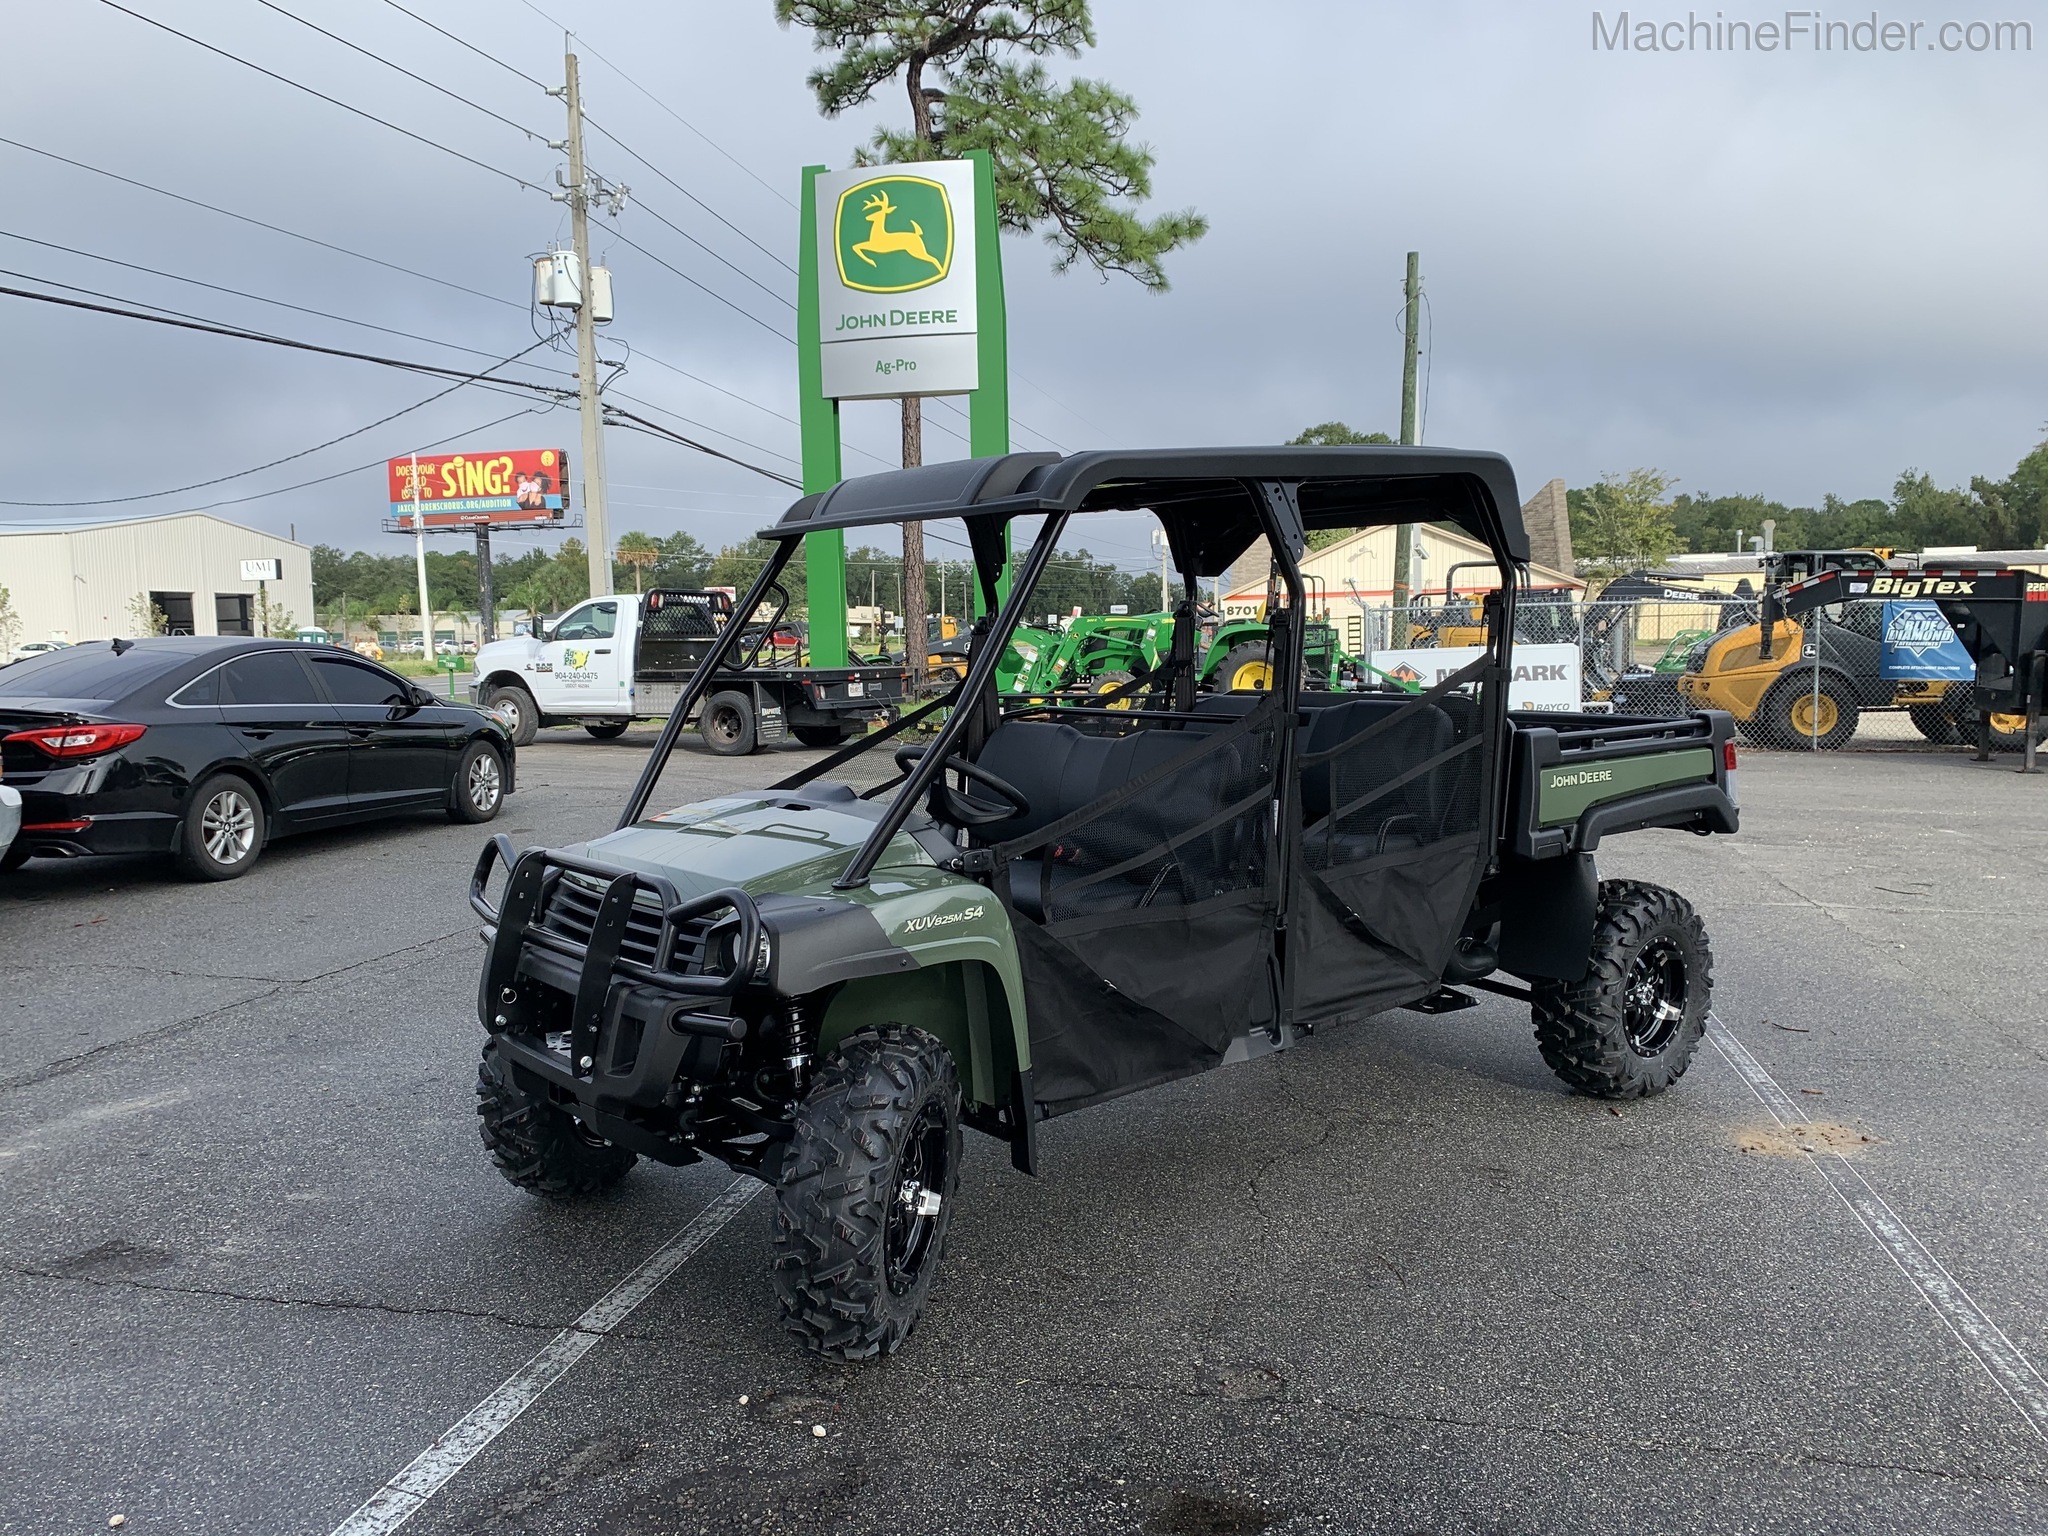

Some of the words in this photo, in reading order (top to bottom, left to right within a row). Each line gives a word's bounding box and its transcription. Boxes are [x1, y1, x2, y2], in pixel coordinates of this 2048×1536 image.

[835, 312, 886, 331] JOHN
[889, 309, 958, 326] DEERE
[875, 358, 917, 375] Ag-Pro
[422, 487, 432, 499] TO
[245, 560, 271, 572] UMI
[1663, 588, 1700, 600] DEERE
[1226, 605, 1258, 616] 8701
[1903, 620, 1939, 631] BLUE
[1888, 629, 1953, 641] DIAMOND
[554, 672, 599, 680] 904-240-0475
[1436, 664, 1568, 685] MARK
[1536, 703, 1570, 711] RAYCO
[1550, 774, 1578, 788] JOHN
[1579, 770, 1612, 784] DEERE
[903, 912, 963, 933] XUV825M
[963, 905, 984, 920] S4
